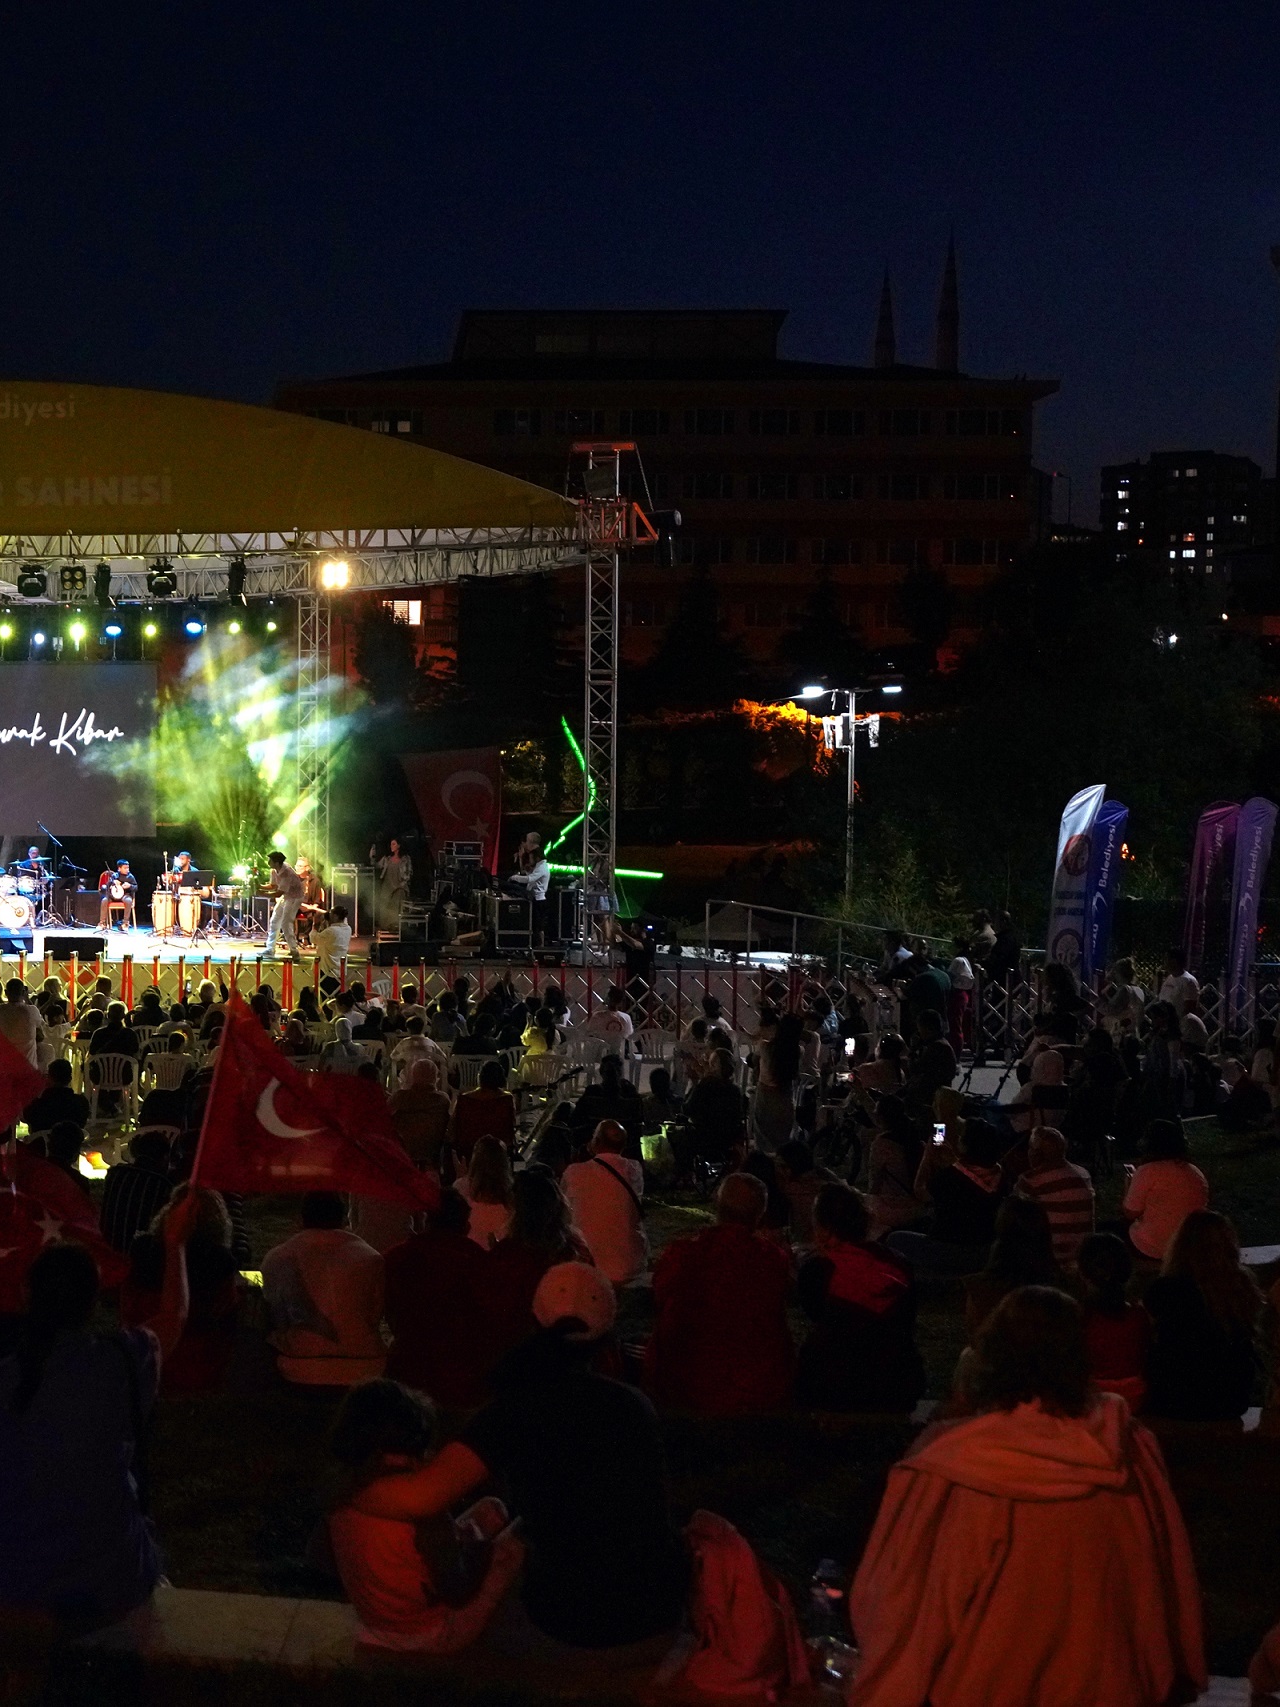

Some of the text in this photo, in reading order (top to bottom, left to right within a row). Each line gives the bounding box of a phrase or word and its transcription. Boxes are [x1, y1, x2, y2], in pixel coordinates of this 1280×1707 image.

[13, 467, 173, 508] SAHNESİ
[49, 707, 125, 756] Kibar
[1098, 823, 1116, 888] Belediyesi
[1246, 825, 1263, 888] Belediyesi
